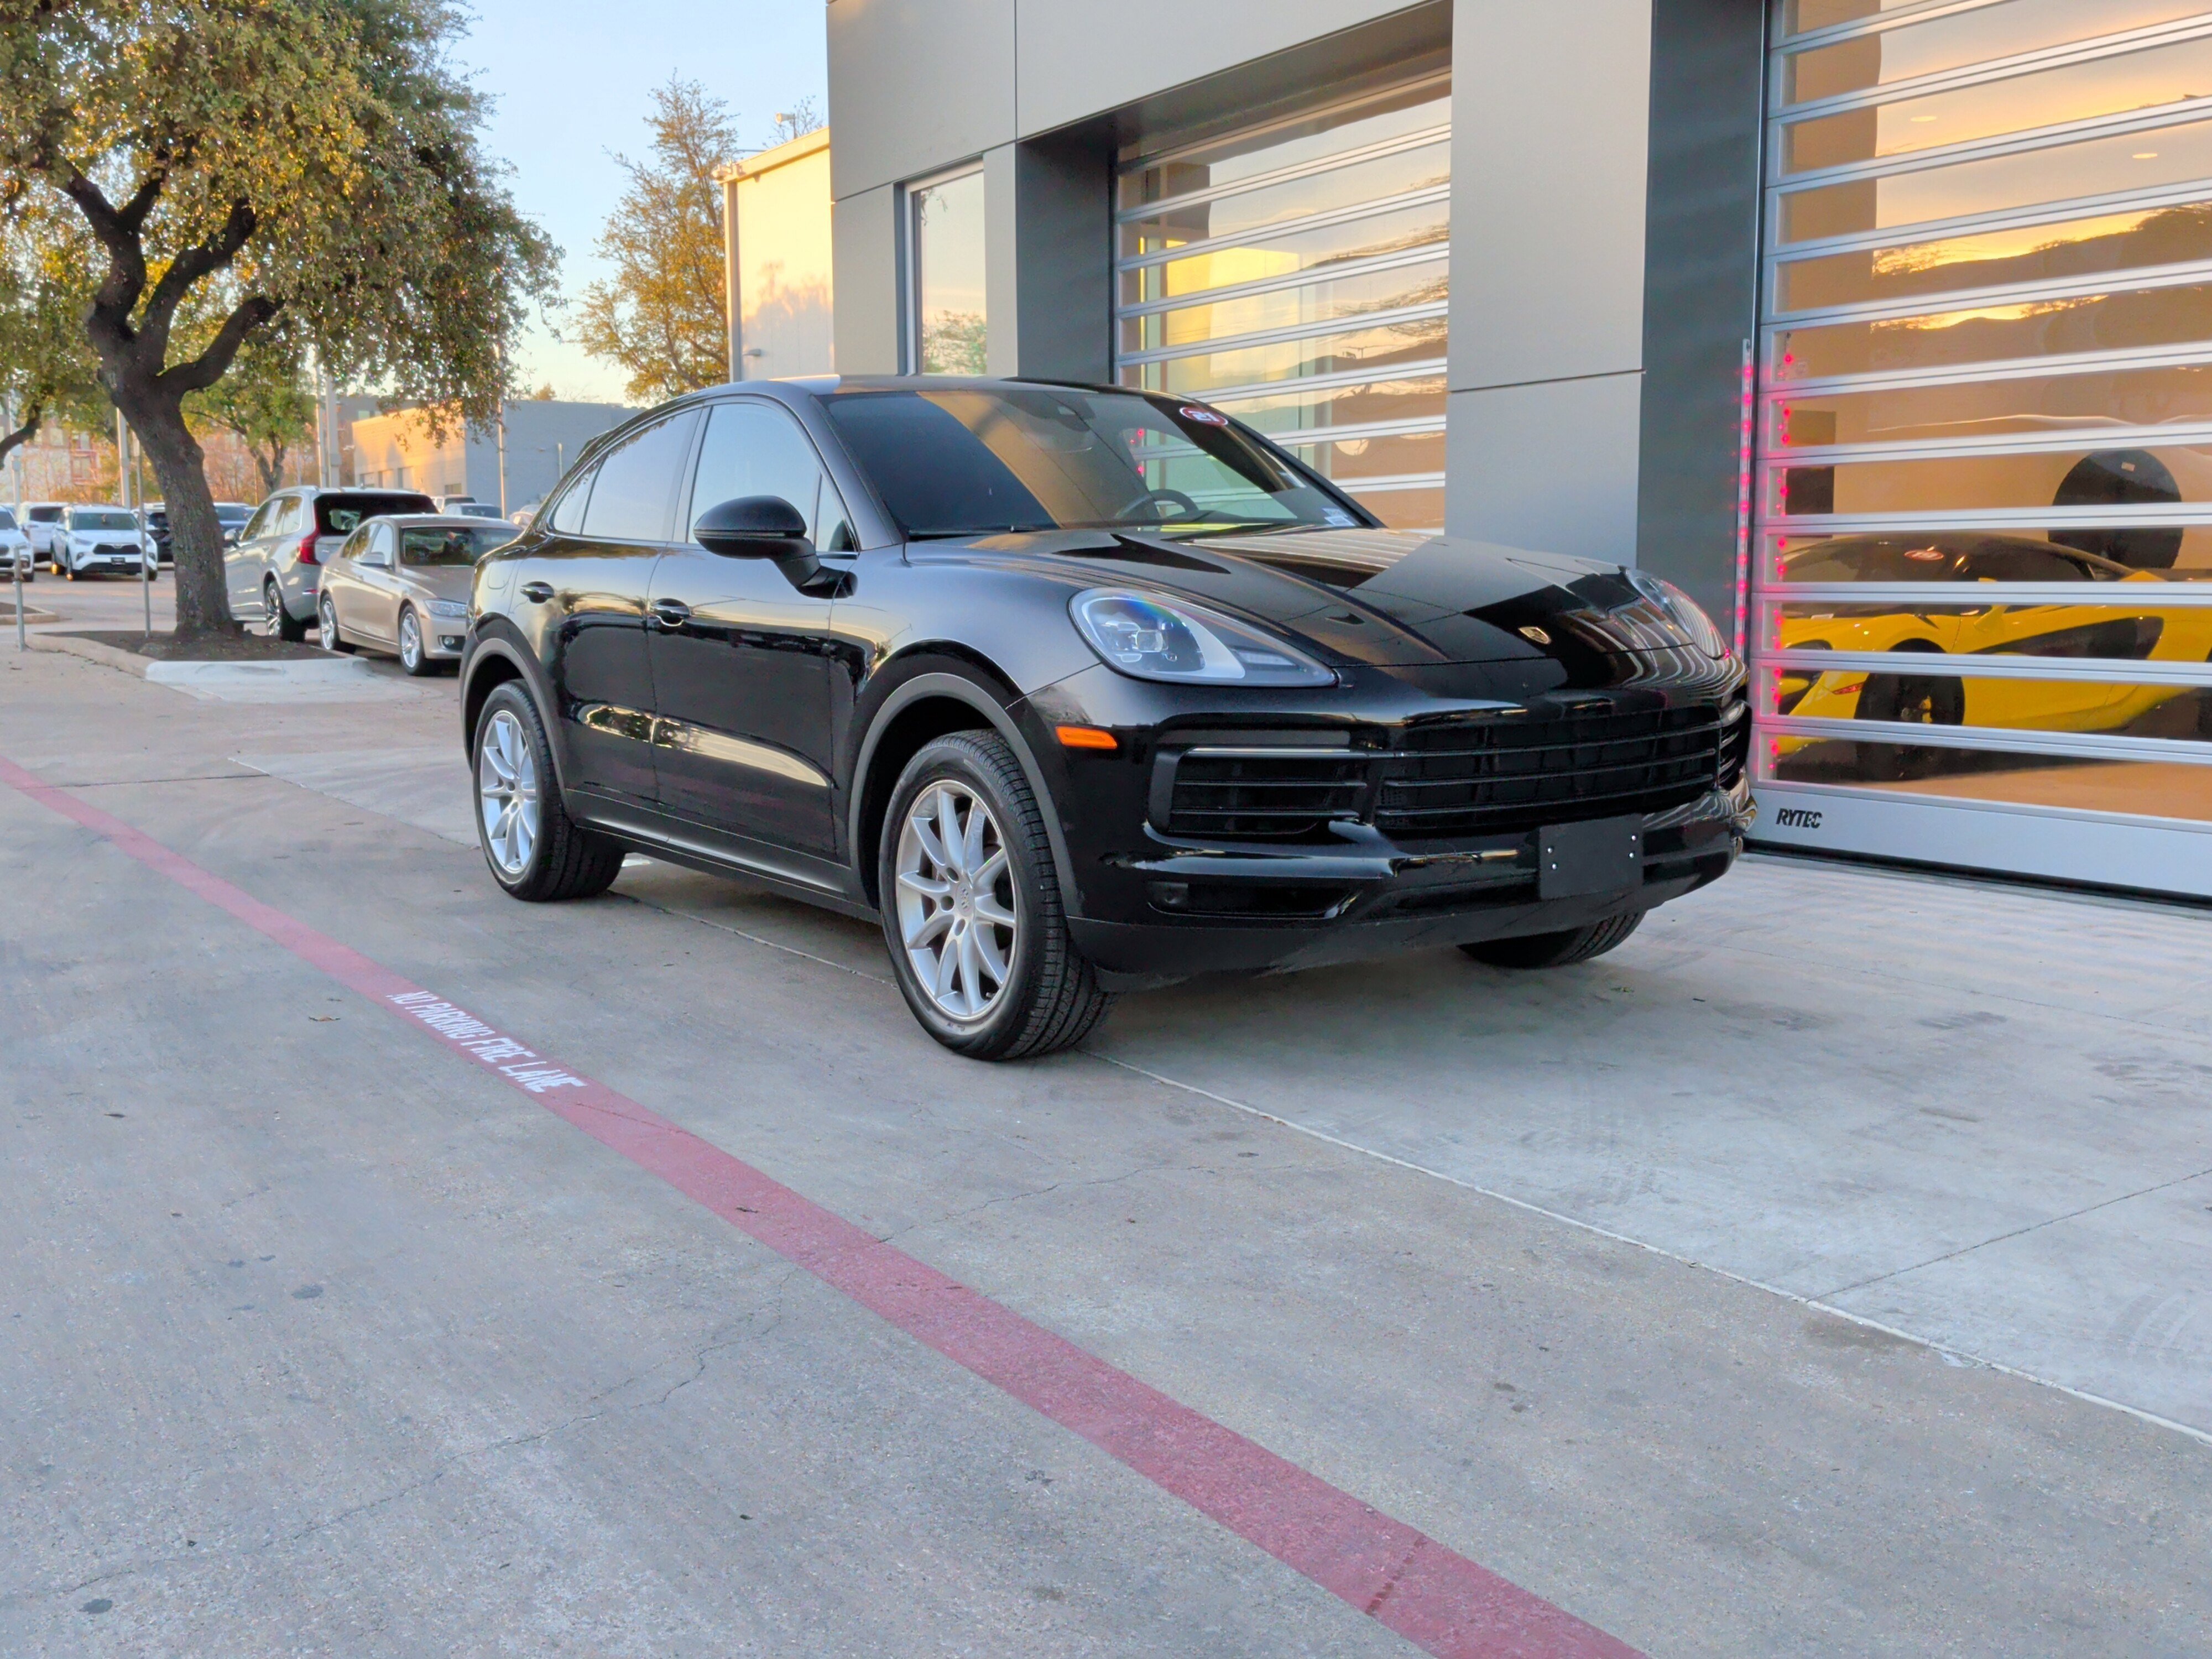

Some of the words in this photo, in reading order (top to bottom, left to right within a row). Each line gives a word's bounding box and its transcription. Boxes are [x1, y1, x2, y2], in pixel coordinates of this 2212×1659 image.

[1775, 808, 1823, 828] RYTEC
[385, 990, 440, 1004] NO
[404, 1003, 495, 1039] PARKING
[460, 1037, 537, 1063] FIRE
[498, 1061, 587, 1093] LANE
